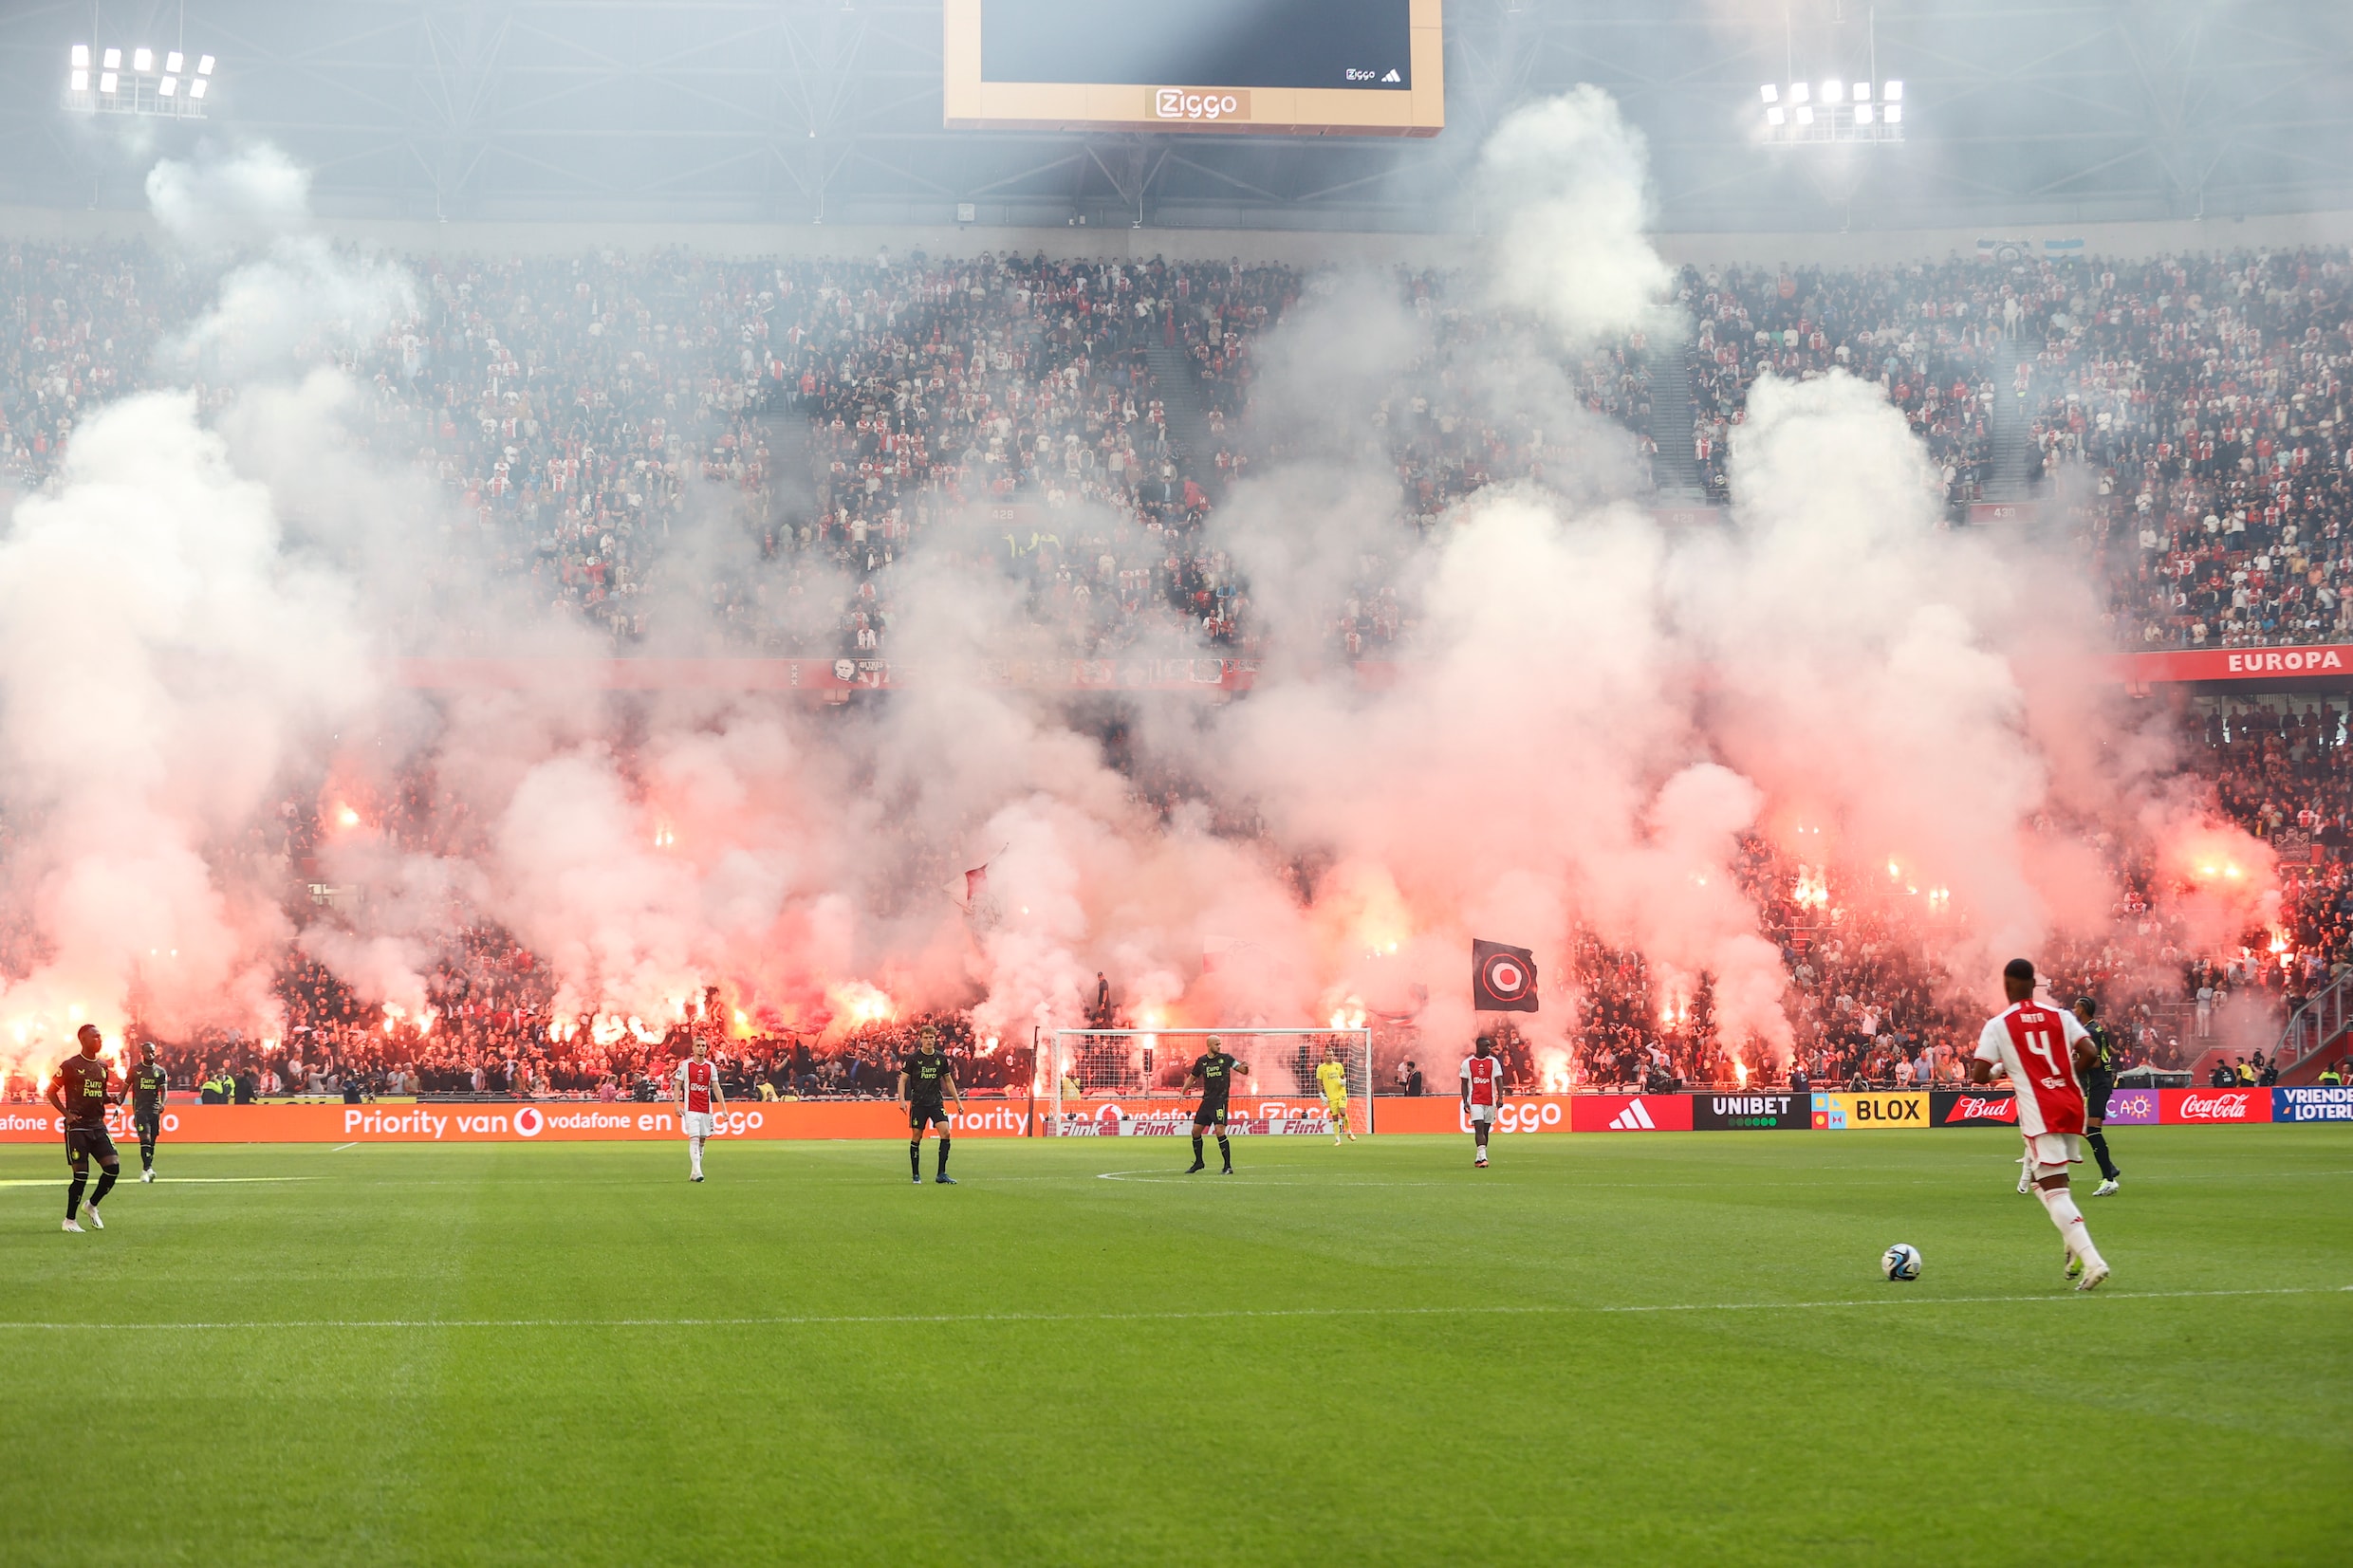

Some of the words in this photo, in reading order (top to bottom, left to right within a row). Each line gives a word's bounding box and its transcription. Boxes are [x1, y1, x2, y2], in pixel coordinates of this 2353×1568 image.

[1346, 68, 1375, 81] Ziggo
[1156, 88, 1237, 119] Ziggo
[992, 509, 1014, 520] 428
[1993, 507, 2016, 518] 430
[2228, 651, 2343, 672] EUROPA
[2025, 1030, 2061, 1076] 4
[83, 1079, 102, 1089] Euro
[1712, 1097, 1791, 1116] UNIBET
[1857, 1099, 1920, 1120] BLOX
[1960, 1098, 2010, 1117] Bud
[2180, 1094, 2250, 1119] Coca-Cola
[2295, 1103, 2353, 1121] LOTERI
[344, 1108, 448, 1138] Priority
[456, 1115, 508, 1134] van
[547, 1111, 631, 1130] vodafone
[638, 1114, 672, 1132] en
[929, 1106, 1029, 1135] riority
[1060, 1121, 1105, 1136] Flink
[1133, 1121, 1177, 1136] Flink
[1282, 1120, 1326, 1134] Flink
